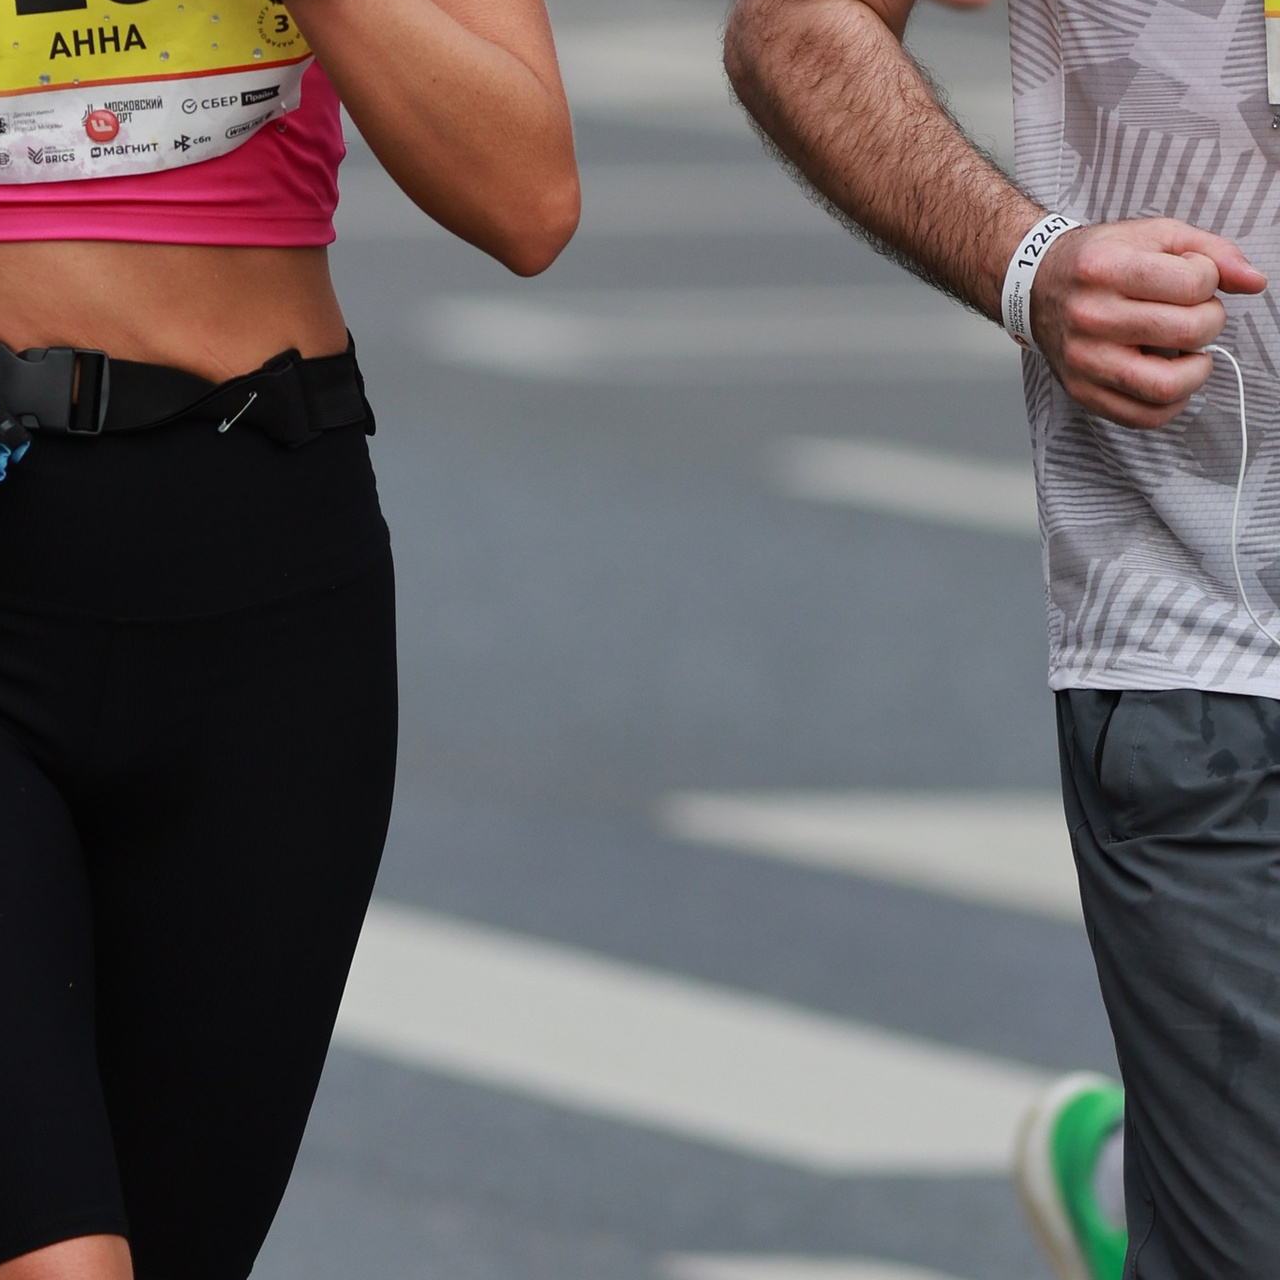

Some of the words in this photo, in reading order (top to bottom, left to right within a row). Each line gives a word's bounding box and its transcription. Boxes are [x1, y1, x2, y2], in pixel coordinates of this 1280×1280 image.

[274, 14, 289, 33] 3
[48, 23, 147, 61] АННА
[104, 96, 163, 112] МОСКОВСКИЙ
[201, 95, 238, 109] СБЕР
[116, 111, 132, 124] ОРТ
[104, 143, 158, 156] магнит
[45, 153, 75, 164] BRICS
[1018, 216, 1069, 268] 12247
